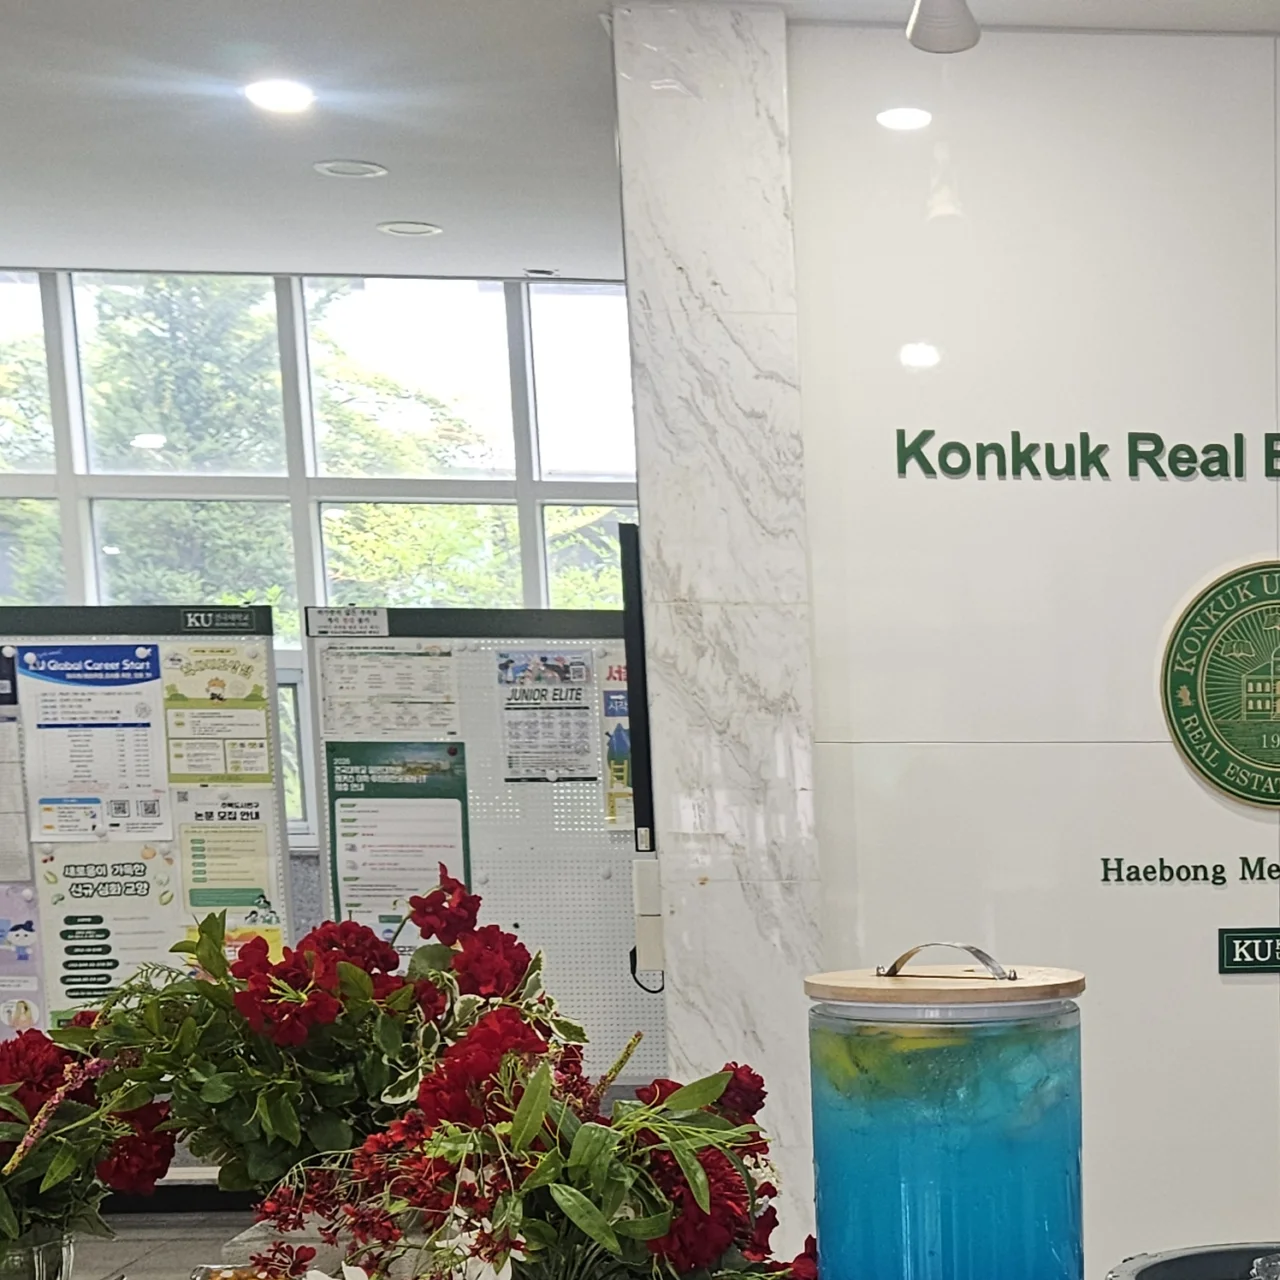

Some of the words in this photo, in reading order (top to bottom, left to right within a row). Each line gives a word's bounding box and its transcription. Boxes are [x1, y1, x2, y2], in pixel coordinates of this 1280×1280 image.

[896, 428, 1110, 479] Konkuk
[1128, 431, 1244, 478] Real
[186, 612, 213, 628] KU
[1172, 580, 1257, 677] KONKUK
[47, 659, 83, 671] Global
[84, 659, 120, 670] Career
[122, 658, 151, 670] Start
[506, 687, 548, 701] JUNIOR
[551, 687, 583, 701] ELITE
[1181, 713, 1221, 767] REAL
[194, 811, 215, 821] 논문
[217, 811, 237, 821] 모집
[239, 811, 261, 821] 안내
[63, 864, 108, 879] 새로움이
[111, 862, 147, 877] 가득한
[1100, 858, 1227, 885] Haebong
[124, 881, 151, 896] 교양
[1232, 939, 1274, 962] KU
